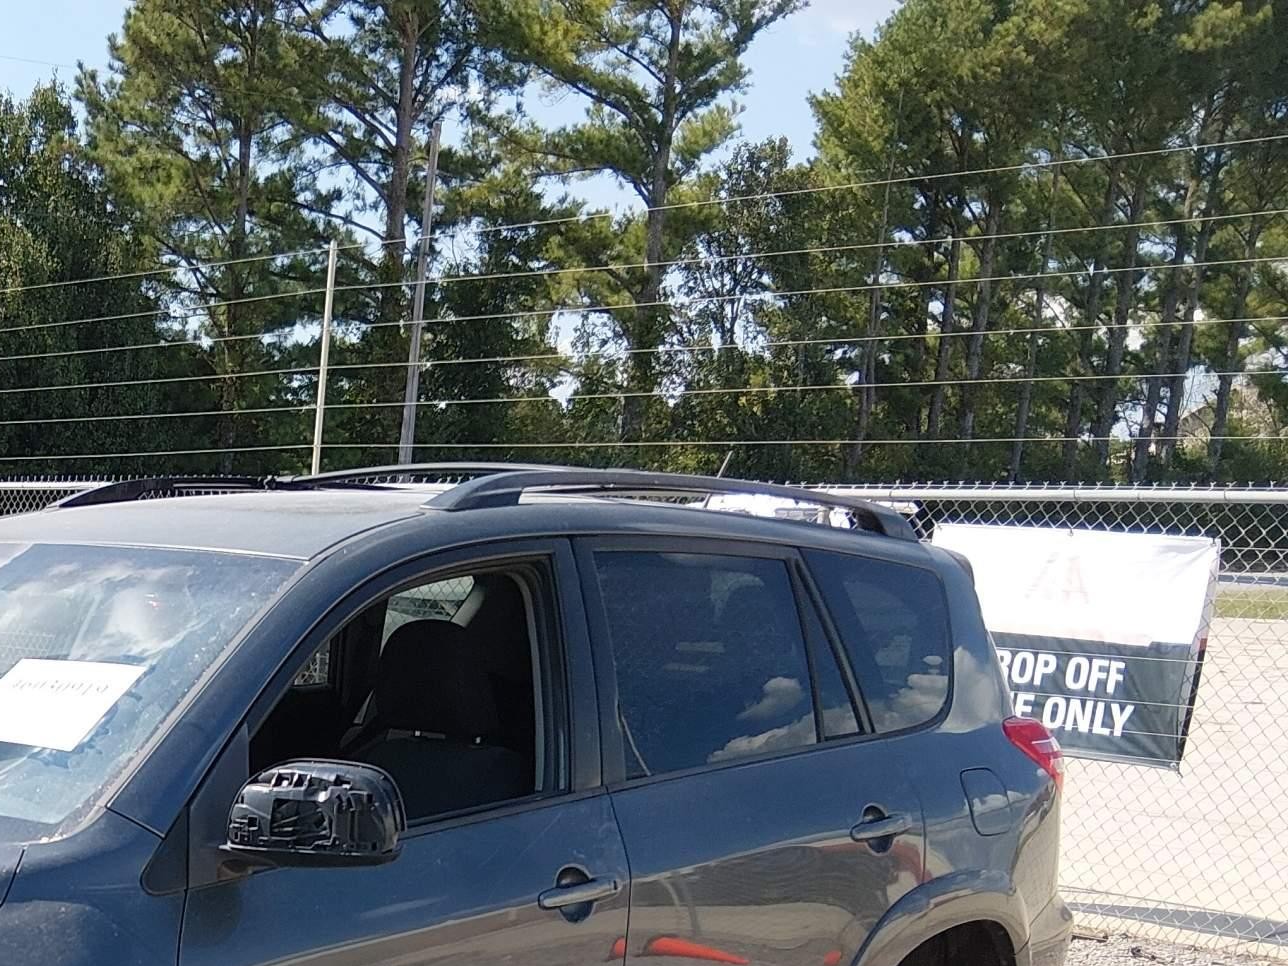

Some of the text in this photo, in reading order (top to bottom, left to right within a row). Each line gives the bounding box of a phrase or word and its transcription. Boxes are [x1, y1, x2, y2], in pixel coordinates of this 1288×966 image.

[1065, 656, 1126, 694] OFF
[1011, 691, 1135, 736] E ONLY
